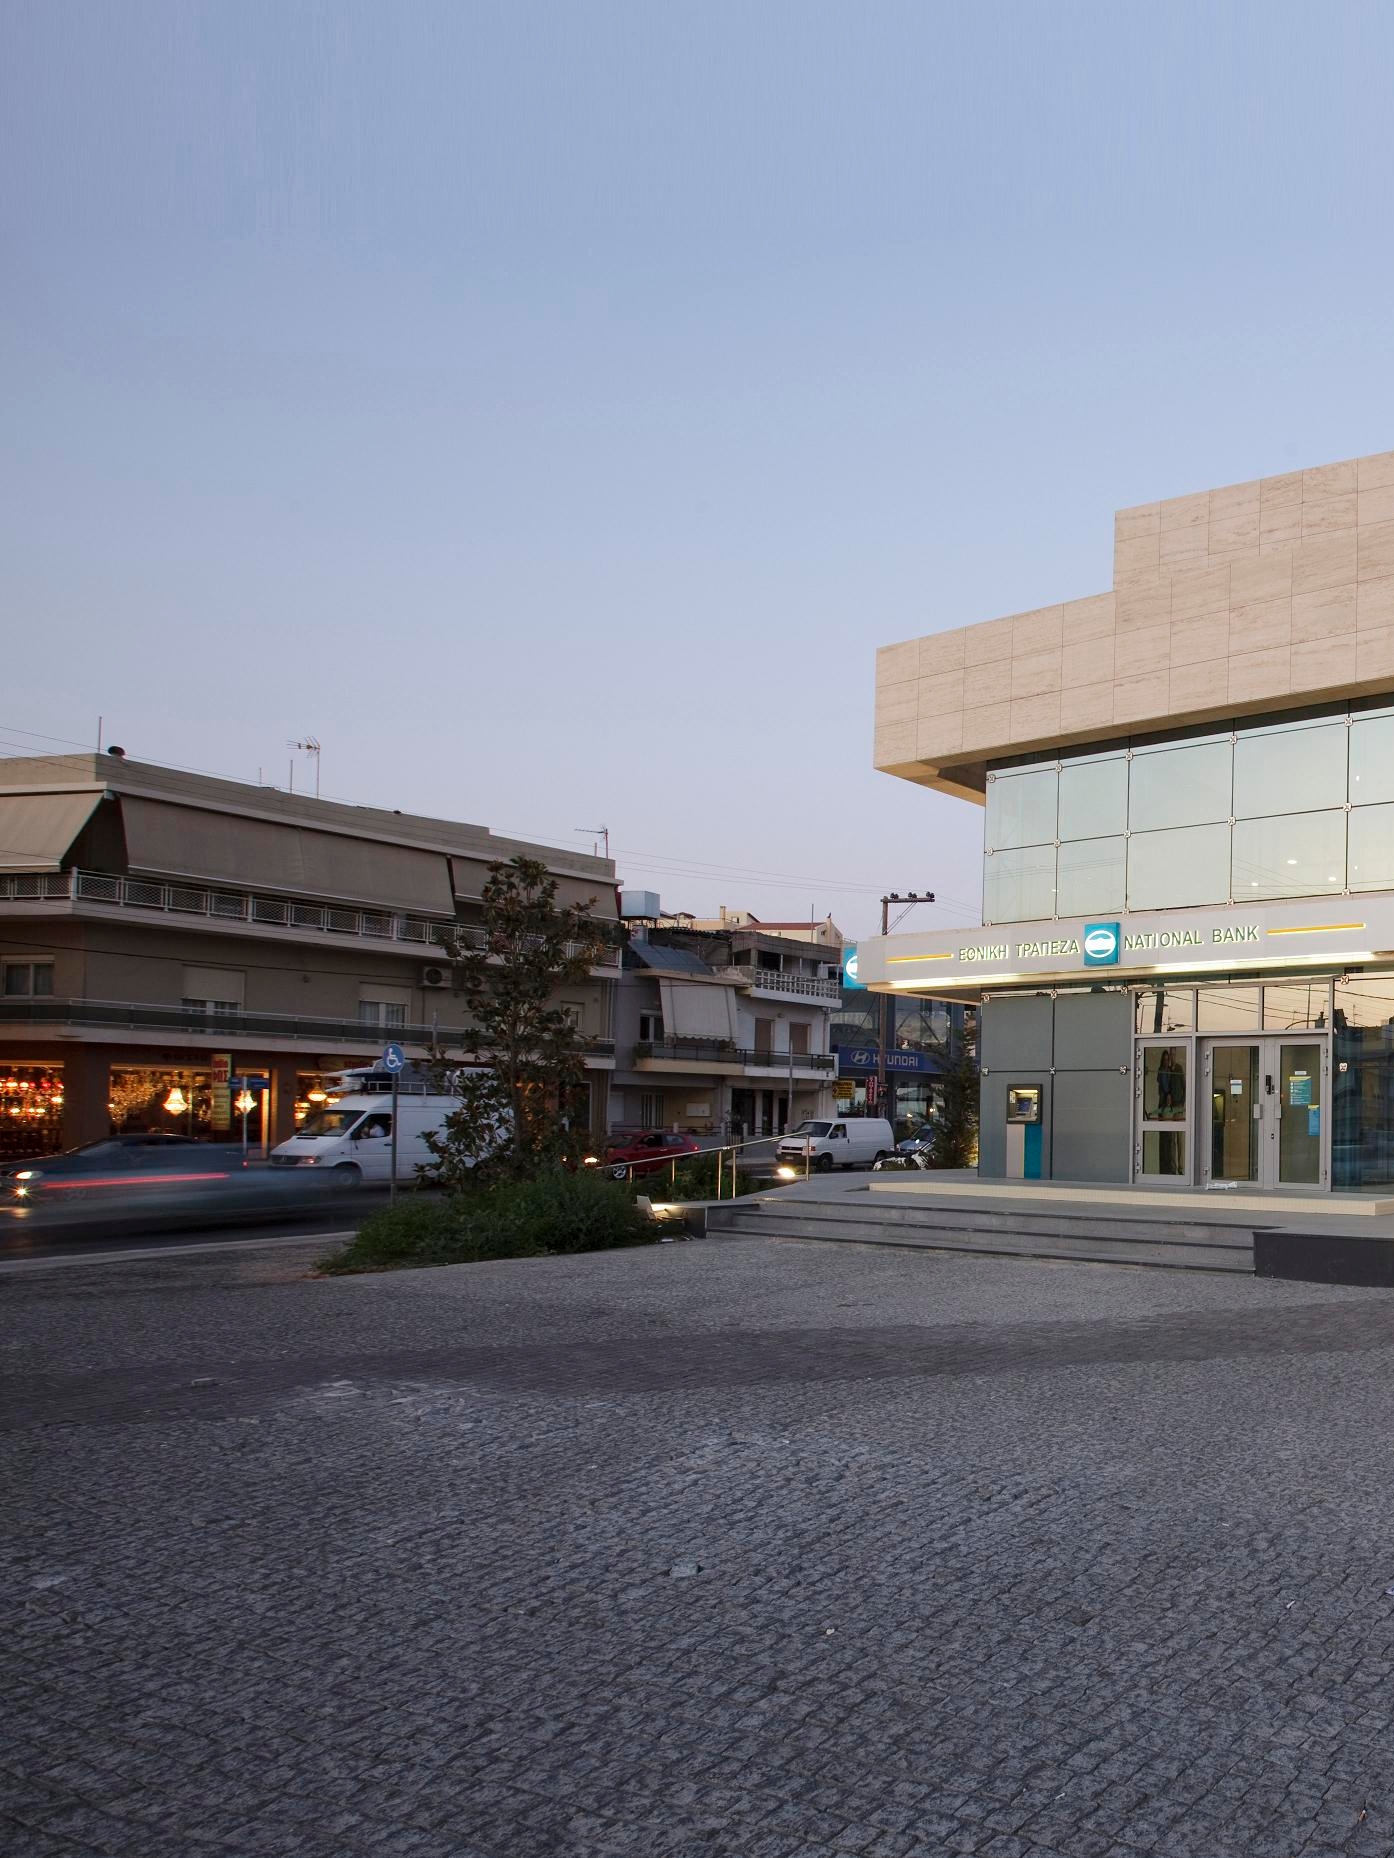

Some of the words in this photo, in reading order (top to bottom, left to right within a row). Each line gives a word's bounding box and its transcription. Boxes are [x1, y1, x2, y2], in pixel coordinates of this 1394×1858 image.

[1124, 930, 1205, 951] NATIONAL
[1212, 925, 1260, 943] BANK
[959, 944, 1009, 962] ΕΘΝΙΚΗ
[1015, 939, 1081, 958] ΤΡΑΠΕΖΑ
[872, 1053, 918, 1067] HUNDAI
